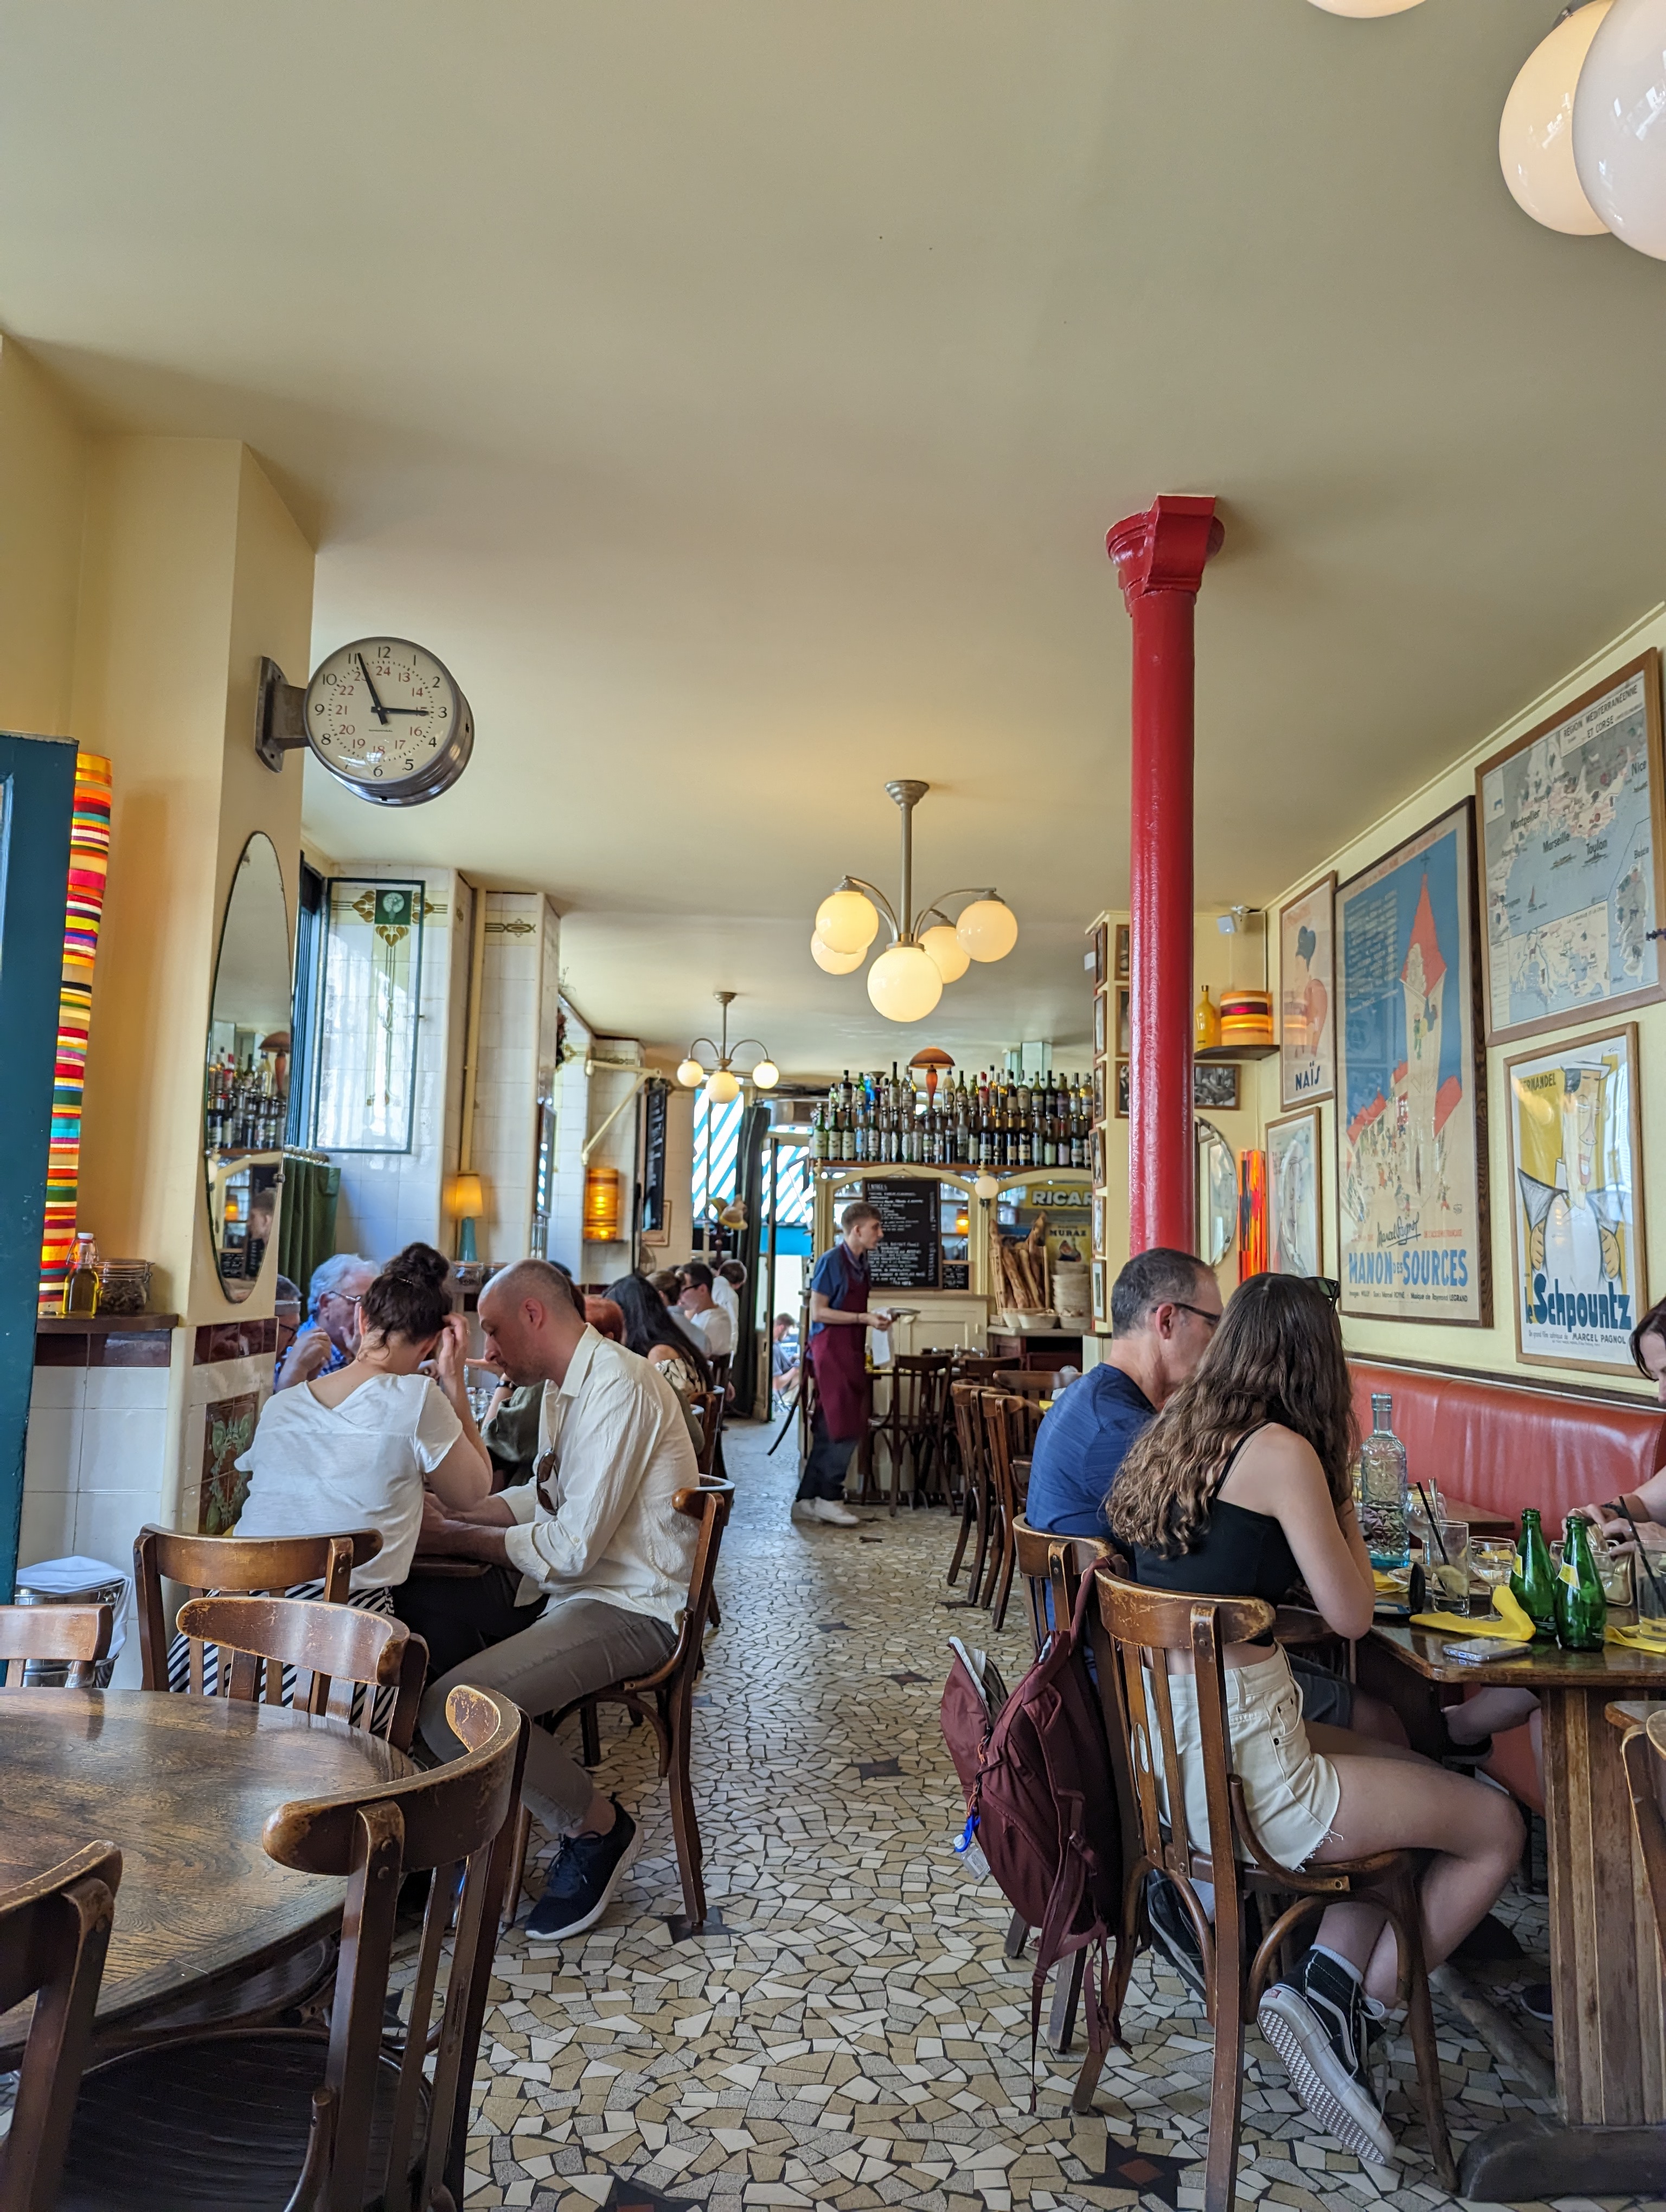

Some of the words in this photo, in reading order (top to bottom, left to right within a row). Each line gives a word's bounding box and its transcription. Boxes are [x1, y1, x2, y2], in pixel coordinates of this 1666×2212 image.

[378, 646, 391, 658] 12
[348, 653, 357, 664] 11
[413, 655, 416, 666] 1
[376, 666, 390, 676] 24
[323, 673, 337, 685] 10
[399, 673, 410, 682] 13
[432, 676, 440, 688] 2
[339, 685, 354, 695] 22
[412, 687, 423, 697] 14
[315, 704, 325, 716] 9
[336, 705, 347, 715] 21
[438, 707, 447, 718] 3
[339, 724, 355, 735] 20
[410, 727, 422, 736] 16
[1587, 728, 1593, 738] ET
[1595, 716, 1614, 733] CORSE
[321, 734, 331, 745] 8
[353, 739, 366, 749] 19
[395, 740, 406, 749] 17
[428, 737, 437, 747] 4
[404, 759, 414, 770] 5
[1631, 760, 1646, 776] Nice
[373, 766, 383, 777] 6
[1510, 809, 1540, 831] Montpellier
[1543, 832, 1570, 853] Marseille
[1586, 839, 1607, 855] Toulon
[1295, 1060, 1321, 1091] NAÏS
[1349, 1251, 1393, 1284] MANON
[1393, 1262, 1403, 1274] DES
[1402, 1249, 1468, 1287] SOURCES
[1524, 1286, 1533, 1324] le
[1533, 1272, 1632, 1333] Schpountz
[1572, 1332, 1598, 1342] MARCEL
[1600, 1334, 1626, 1345] PAGNOL
